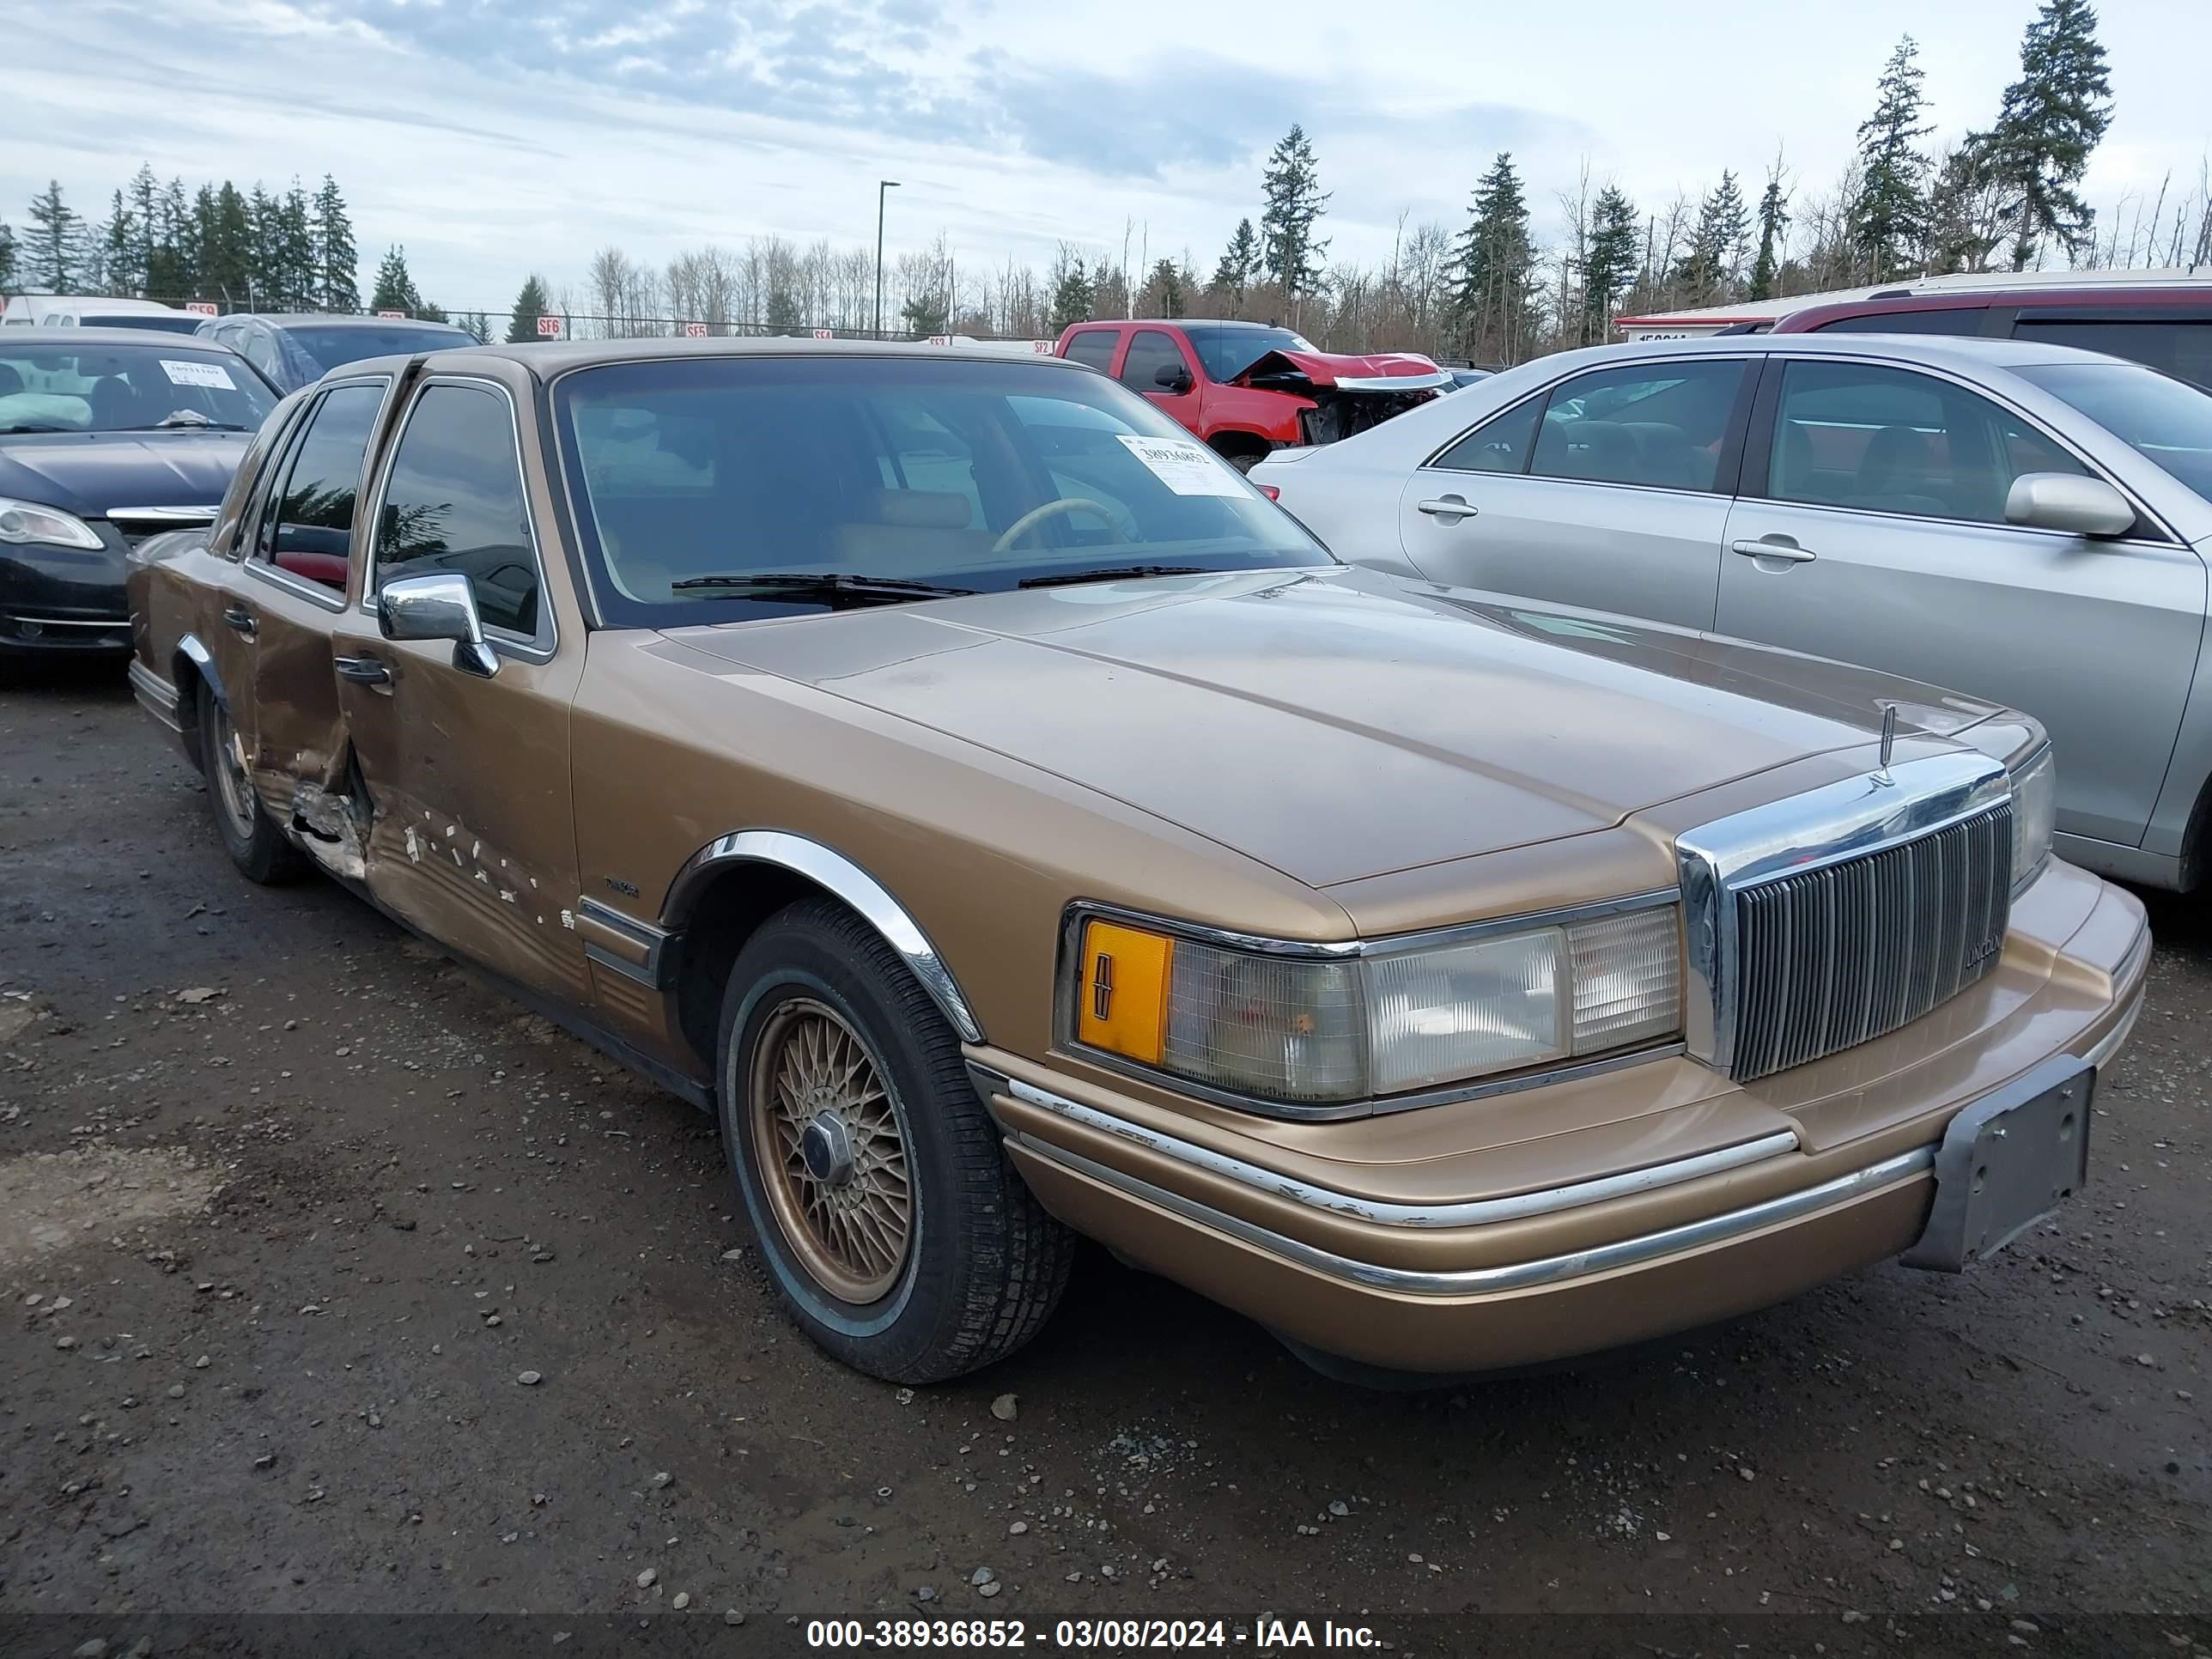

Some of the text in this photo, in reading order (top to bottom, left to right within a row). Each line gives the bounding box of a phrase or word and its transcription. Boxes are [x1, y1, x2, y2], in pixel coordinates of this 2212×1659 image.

[539, 319, 560, 333] SF6
[687, 325, 707, 337] SF5
[1035, 341, 1048, 354] SF2
[1139, 447, 1211, 465] 38936852
